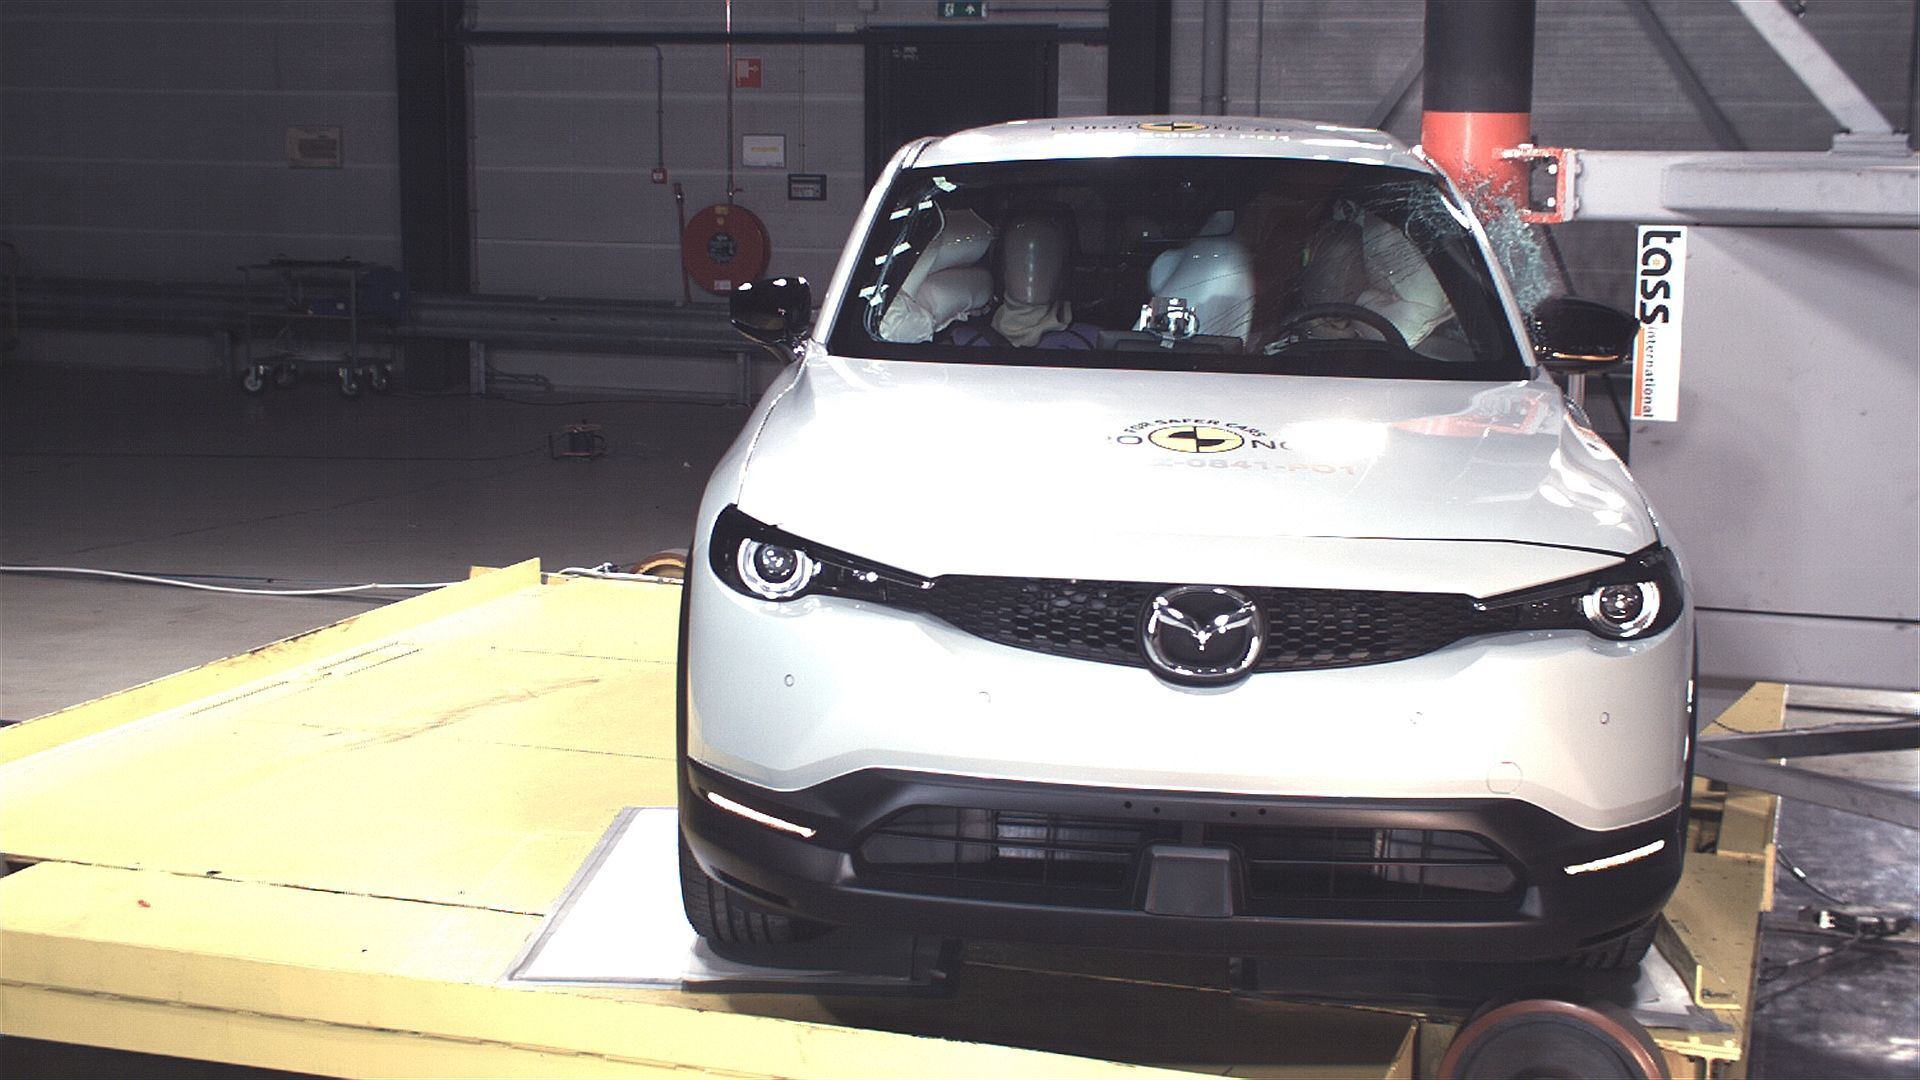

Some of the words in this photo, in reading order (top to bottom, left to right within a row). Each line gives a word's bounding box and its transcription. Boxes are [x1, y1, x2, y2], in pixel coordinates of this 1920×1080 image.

[1640, 230, 1681, 325] tass
[1643, 326, 1657, 417] international
[1226, 423, 1267, 437] CARS
